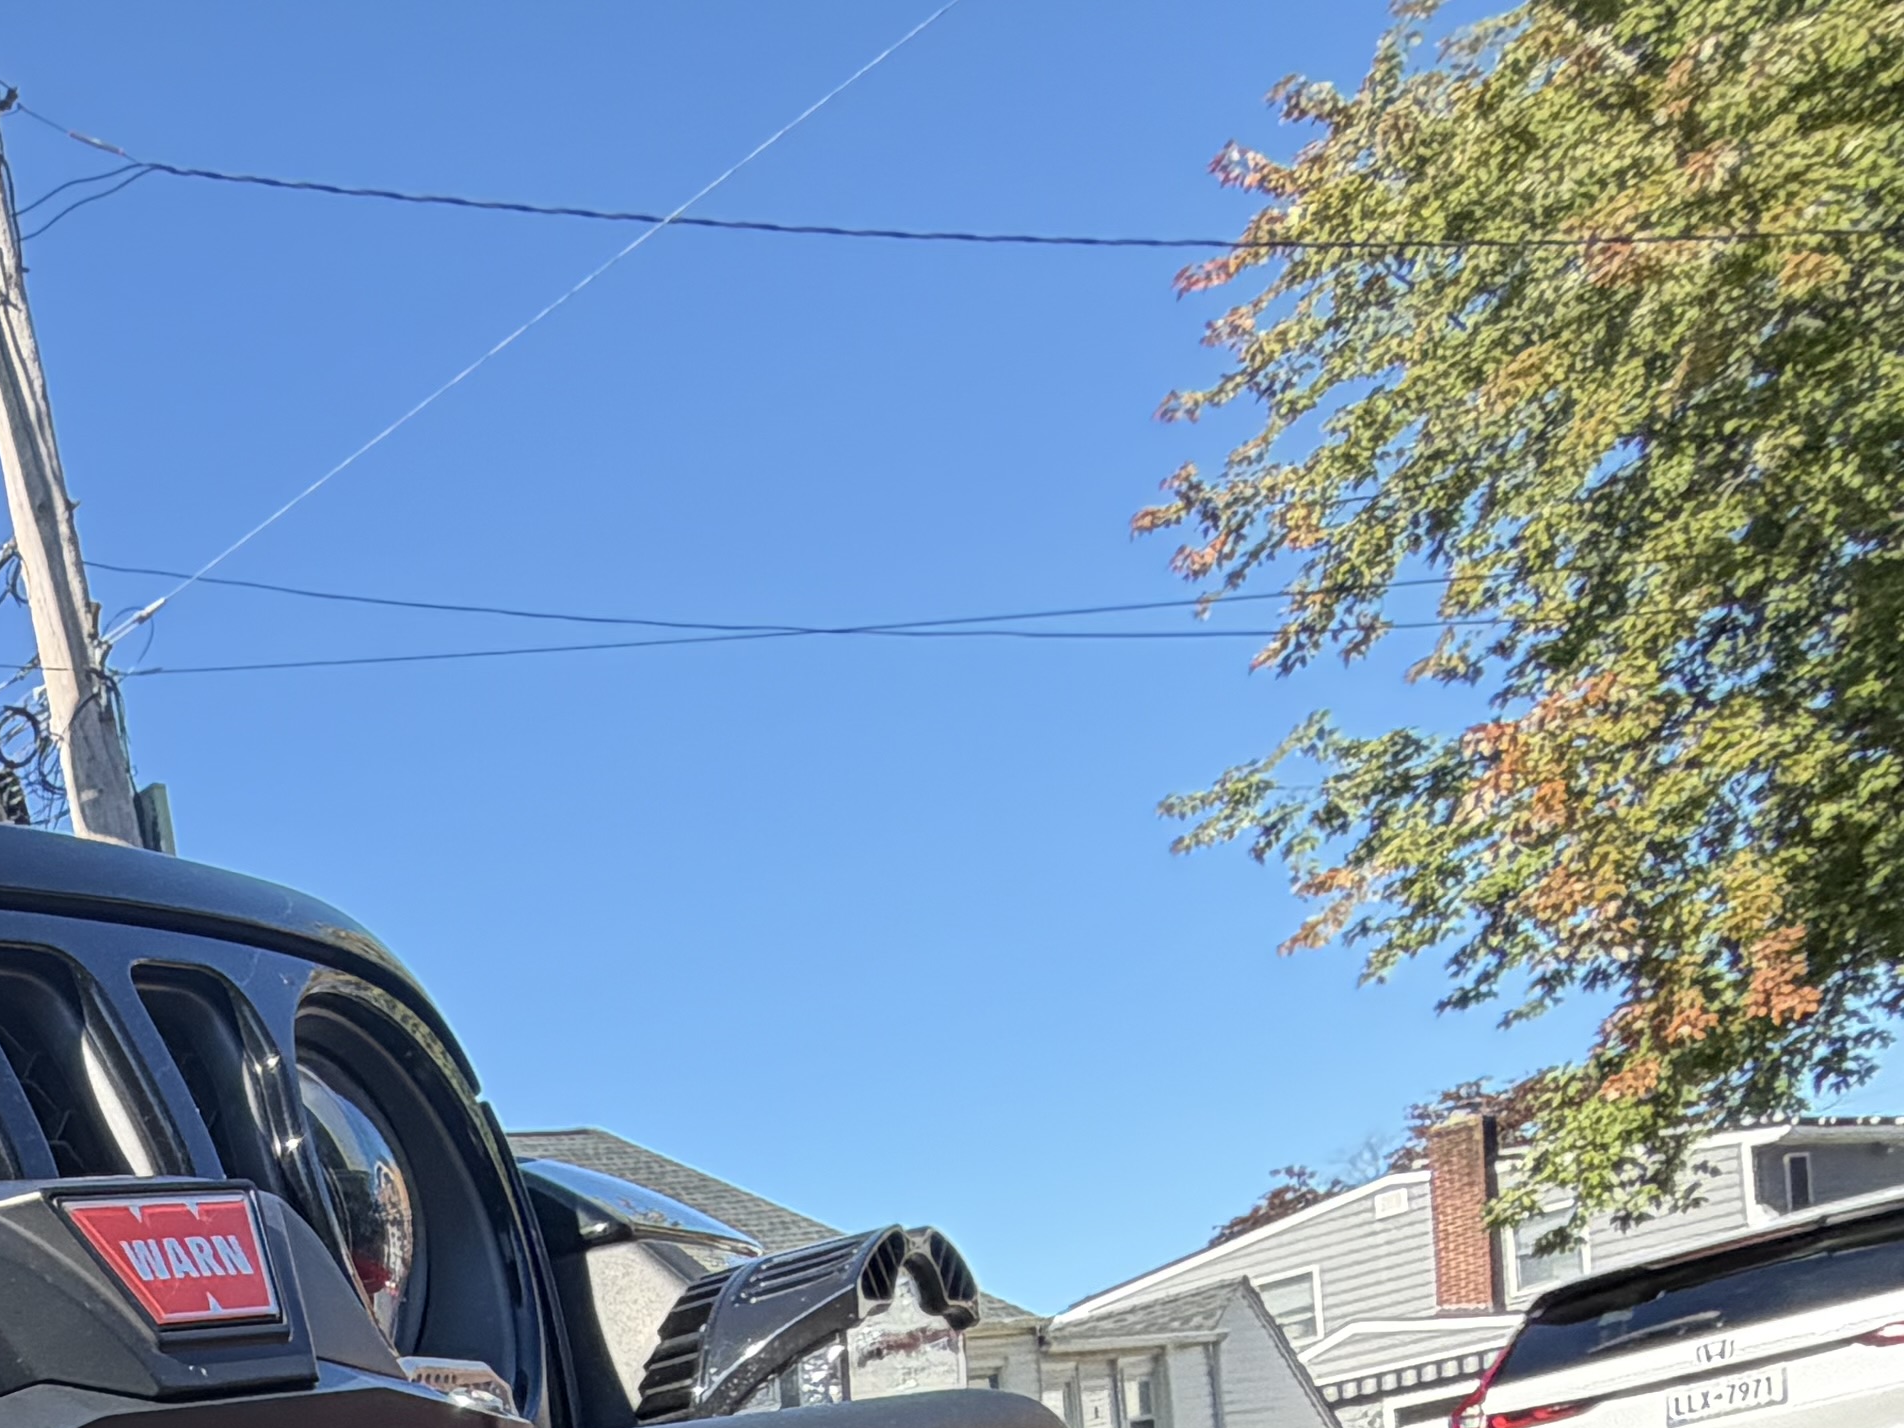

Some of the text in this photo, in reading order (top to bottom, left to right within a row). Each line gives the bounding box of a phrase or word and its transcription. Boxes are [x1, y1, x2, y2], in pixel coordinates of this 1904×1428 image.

[119, 1235, 254, 1281] WARN
[1674, 1376, 1773, 1416] LLX 7971
